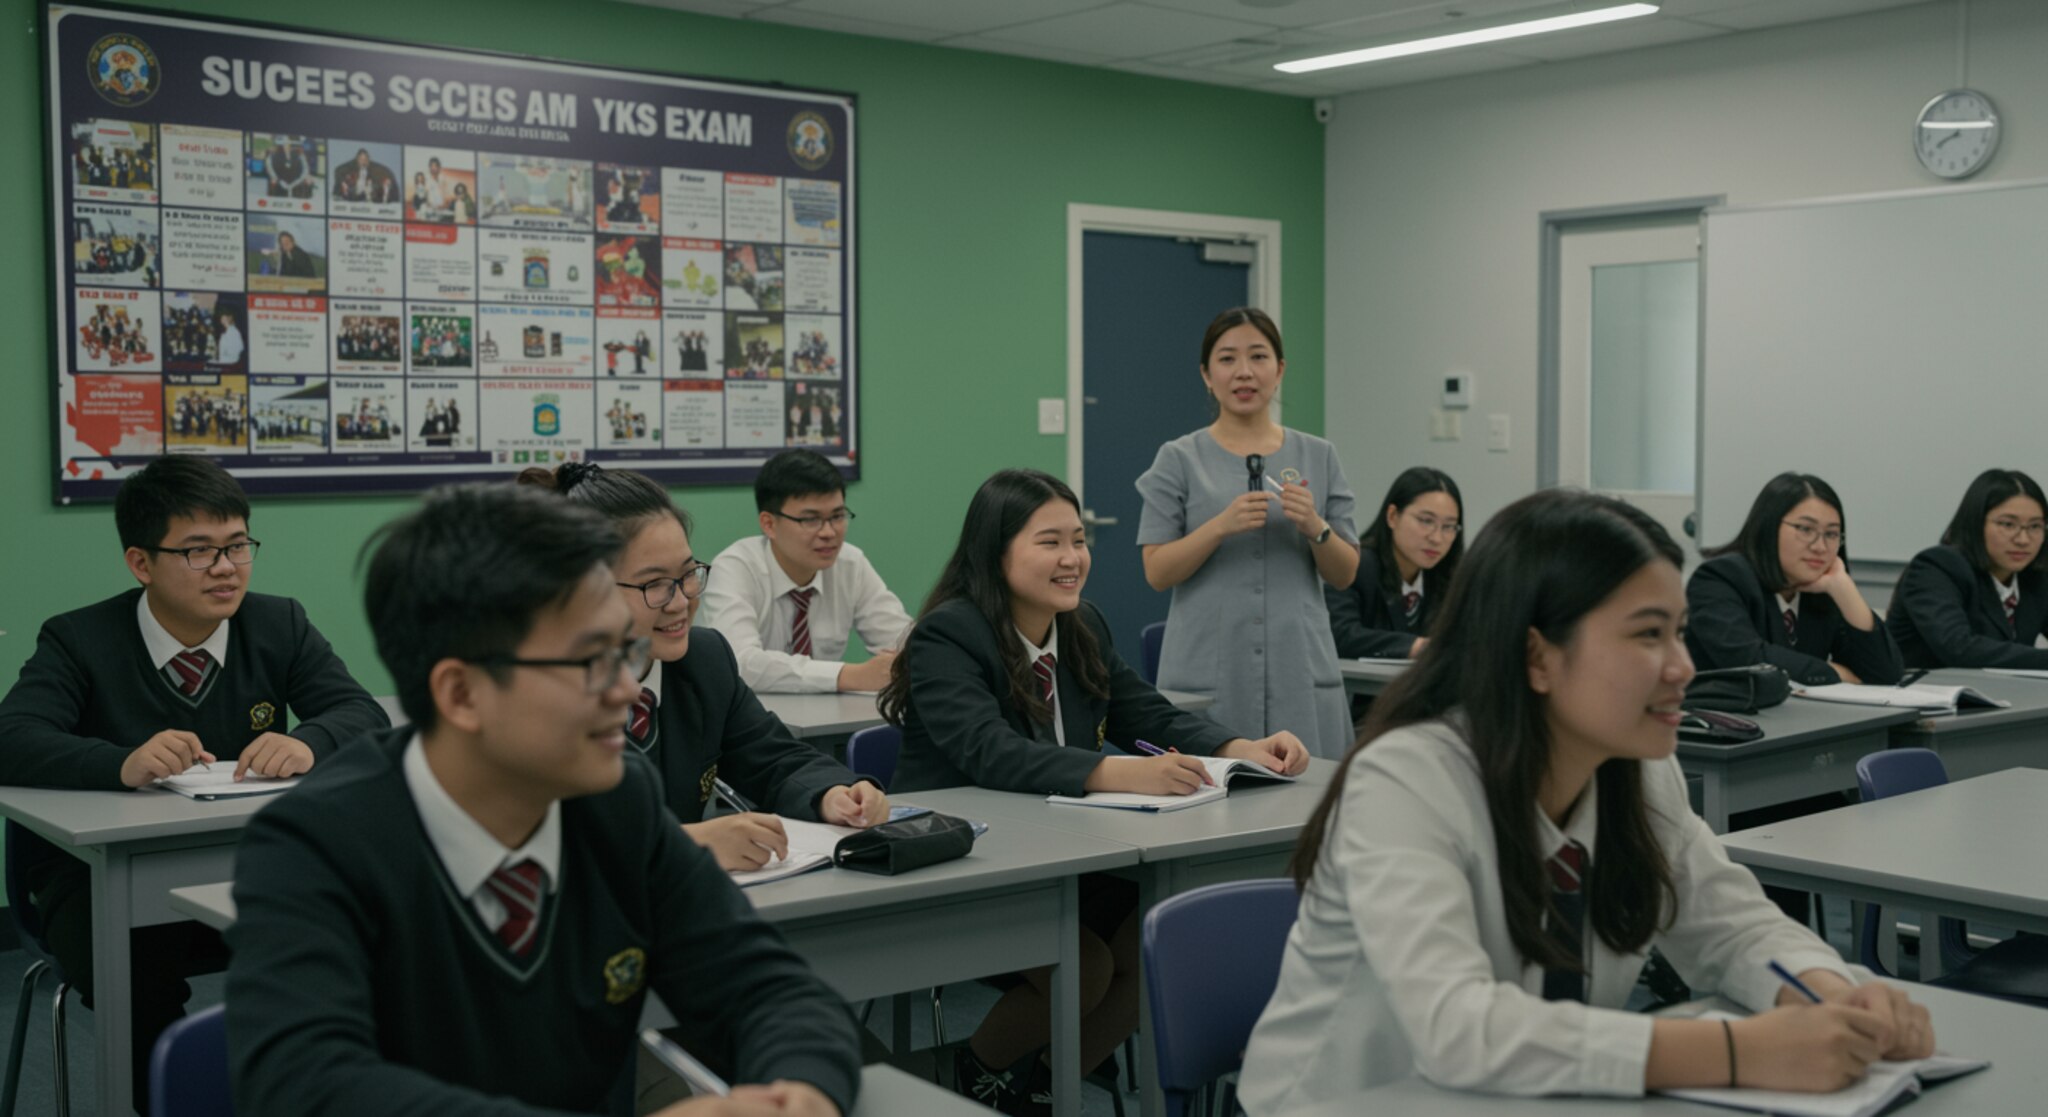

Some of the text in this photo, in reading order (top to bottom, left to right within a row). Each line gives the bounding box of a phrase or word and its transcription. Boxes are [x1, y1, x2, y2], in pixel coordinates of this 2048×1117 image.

[202, 57, 375, 110] SUCEES
[523, 89, 577, 128] AM
[592, 97, 658, 137] YKS
[665, 106, 751, 145] EXAM
